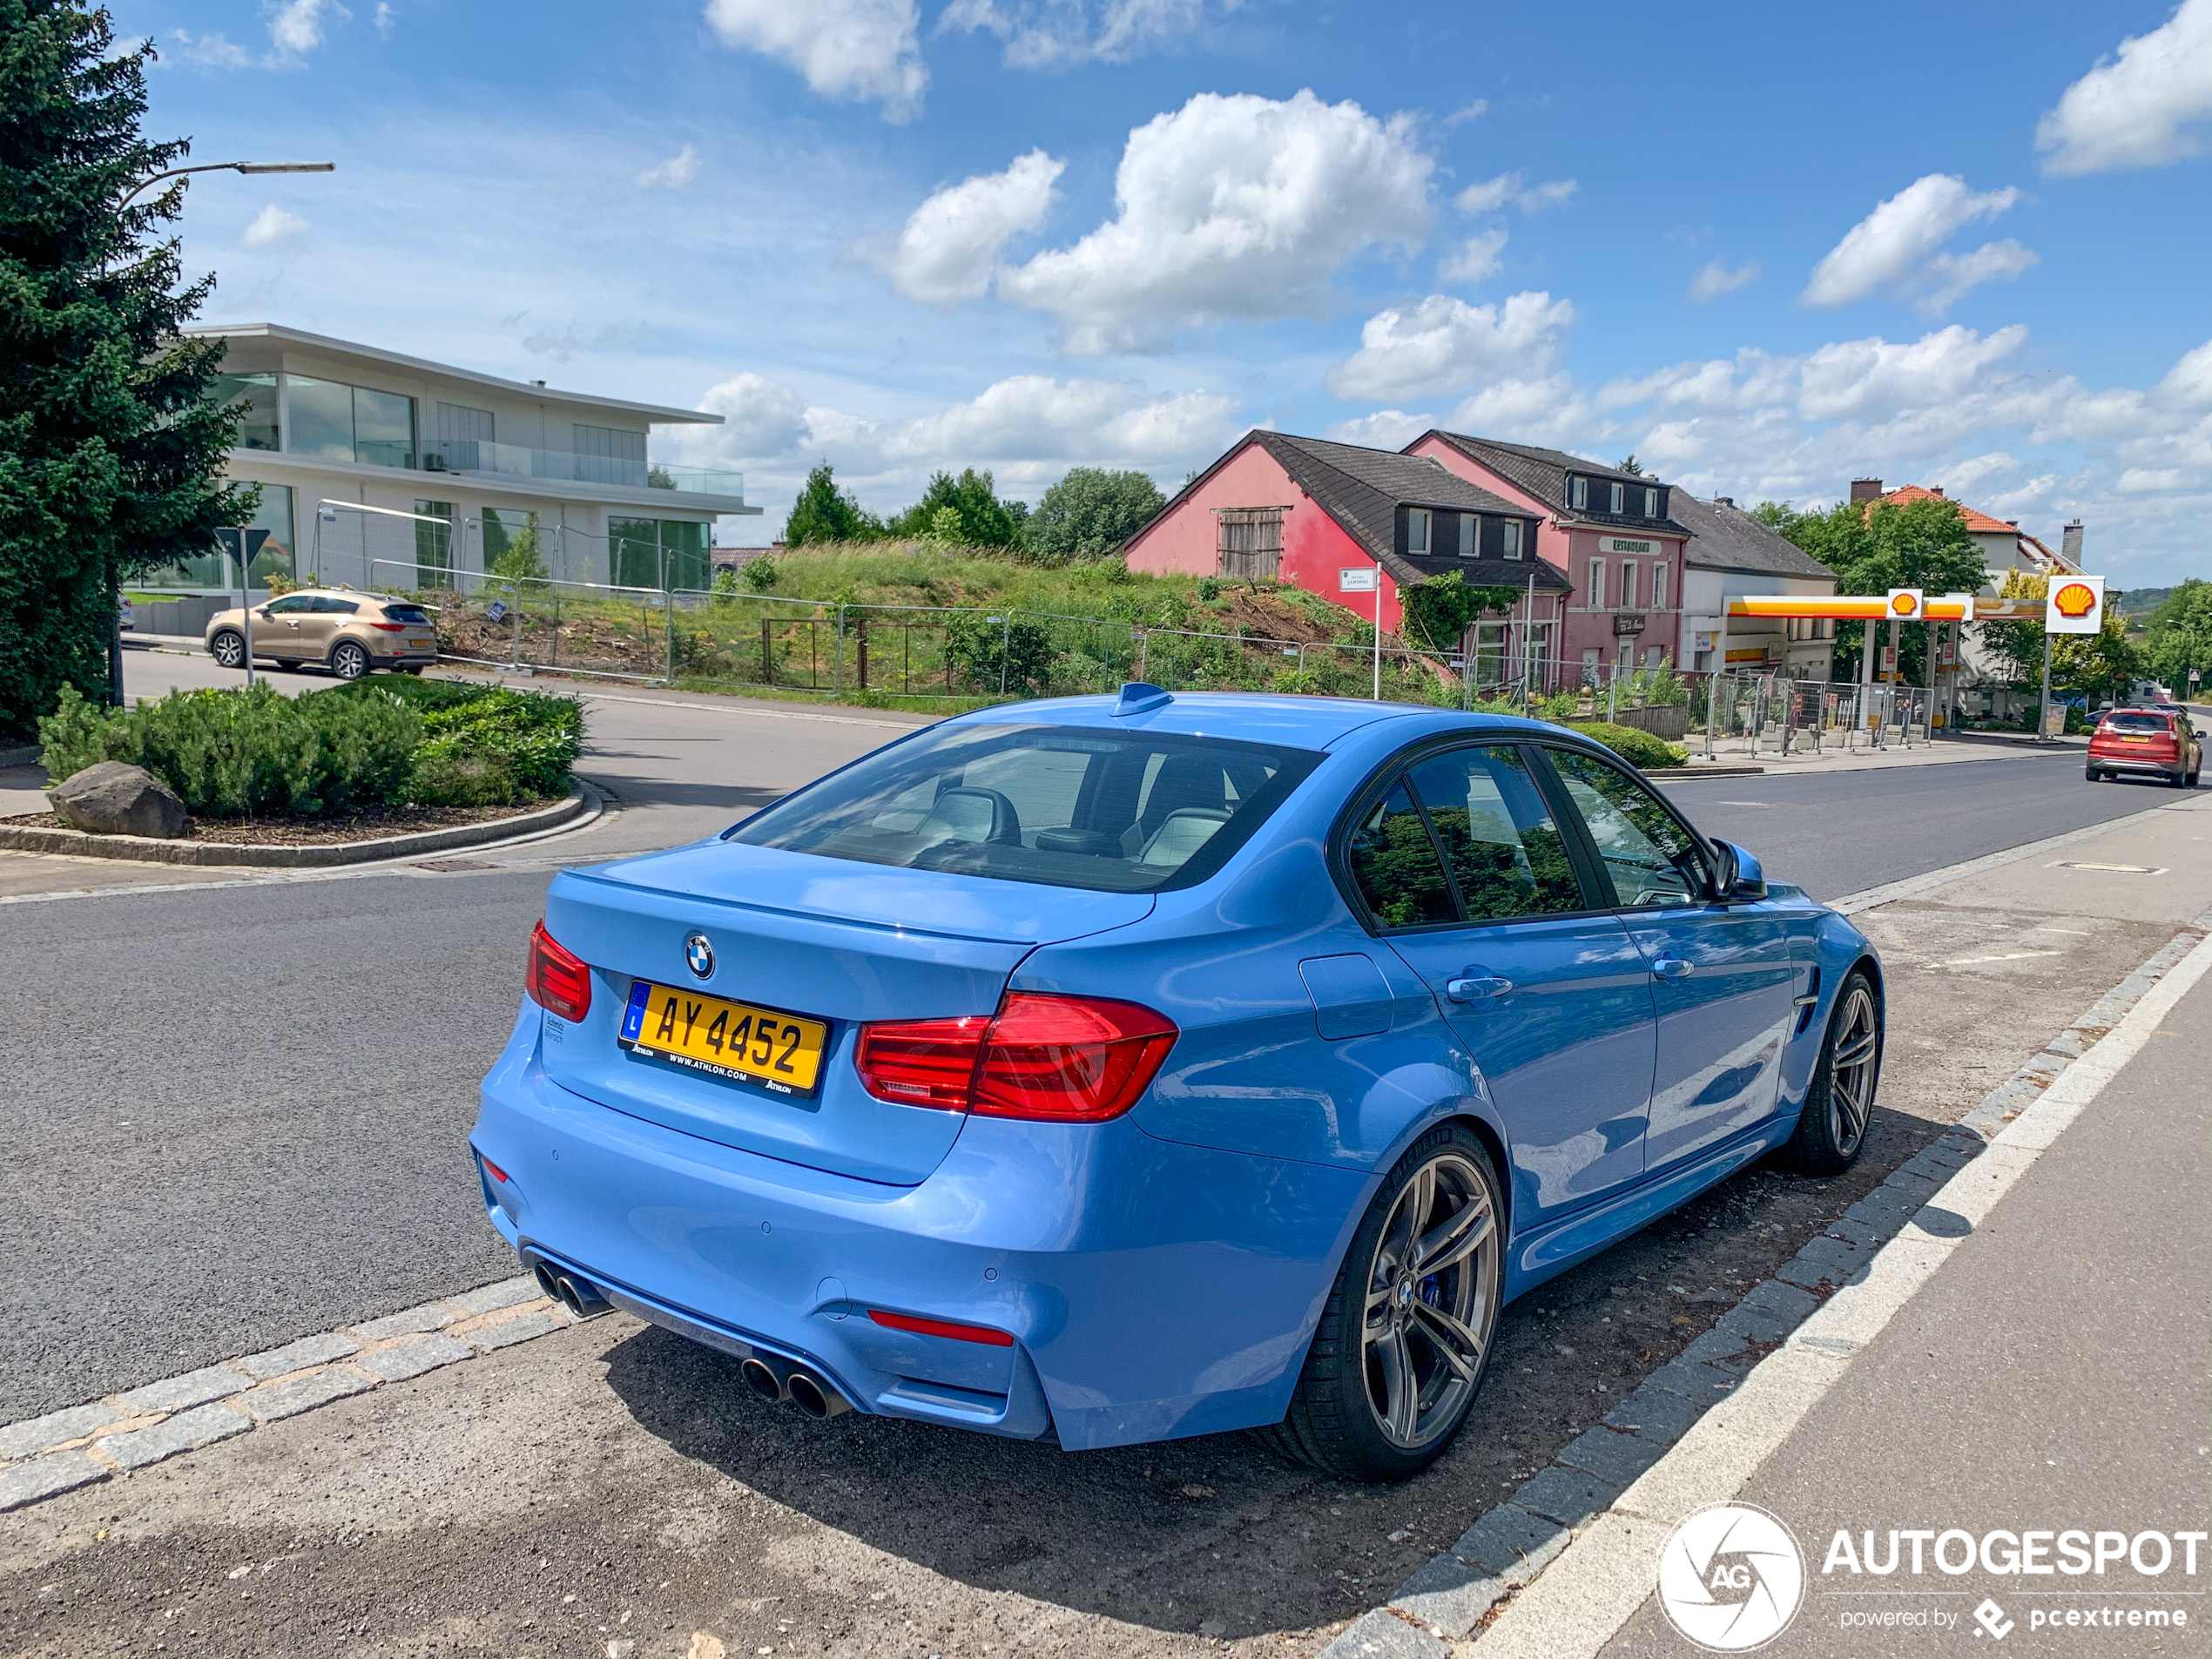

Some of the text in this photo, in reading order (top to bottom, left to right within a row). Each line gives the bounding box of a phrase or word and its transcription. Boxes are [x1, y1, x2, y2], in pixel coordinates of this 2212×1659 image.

[688, 937, 711, 954] BMW
[547, 1015, 564, 1032] Schmitz
[629, 1015, 637, 1031] L
[545, 1028, 563, 1044] Mersch
[656, 997, 801, 1074] AY 4452
[670, 1054, 747, 1082] WWW.ATHLON.COM
[1393, 1129, 1449, 1183] MICHELIN
